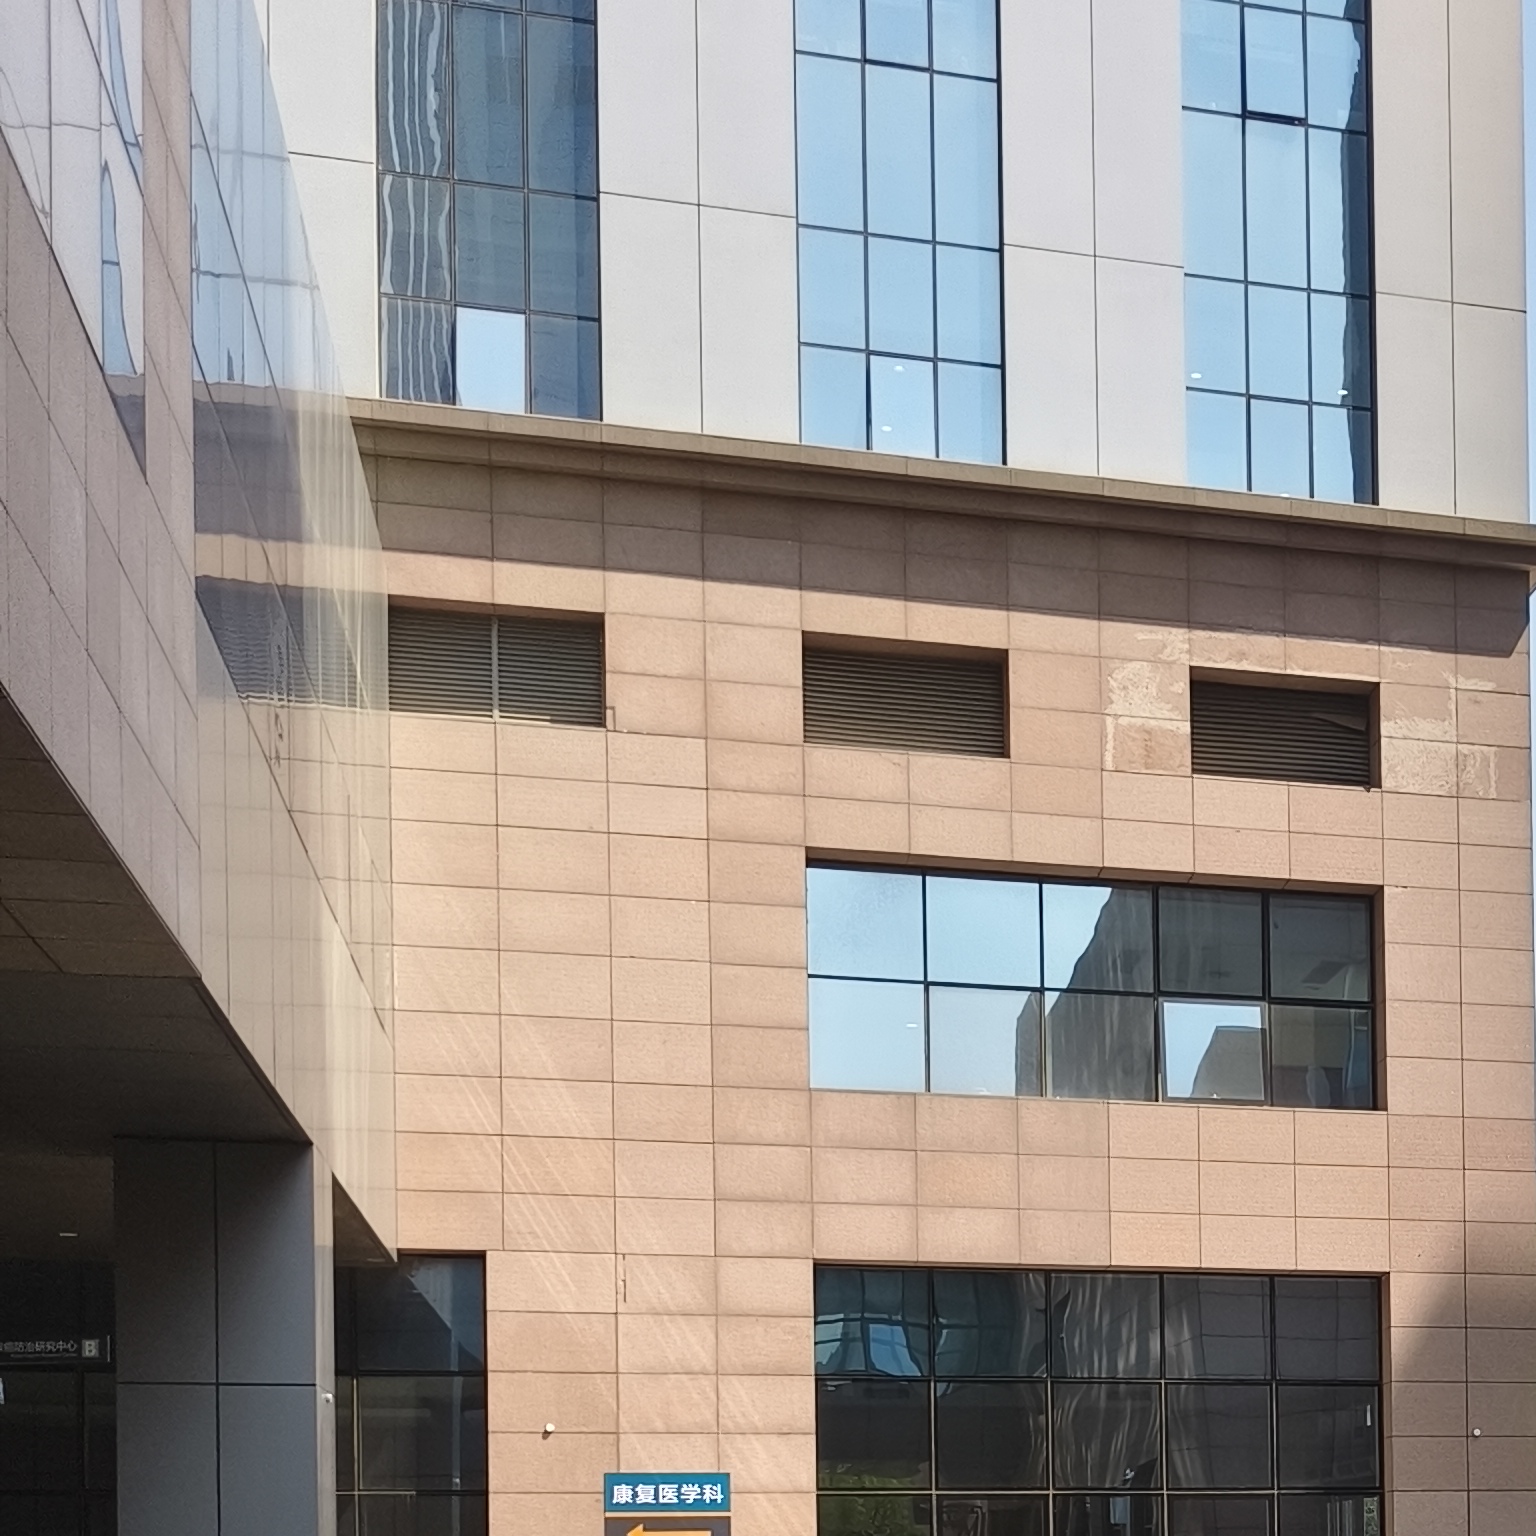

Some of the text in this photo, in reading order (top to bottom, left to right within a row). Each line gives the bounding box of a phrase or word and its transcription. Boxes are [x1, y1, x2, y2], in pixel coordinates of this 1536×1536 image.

[85, 1341, 96, 1356] B
[612, 1483, 724, 1504] 康复医学科
